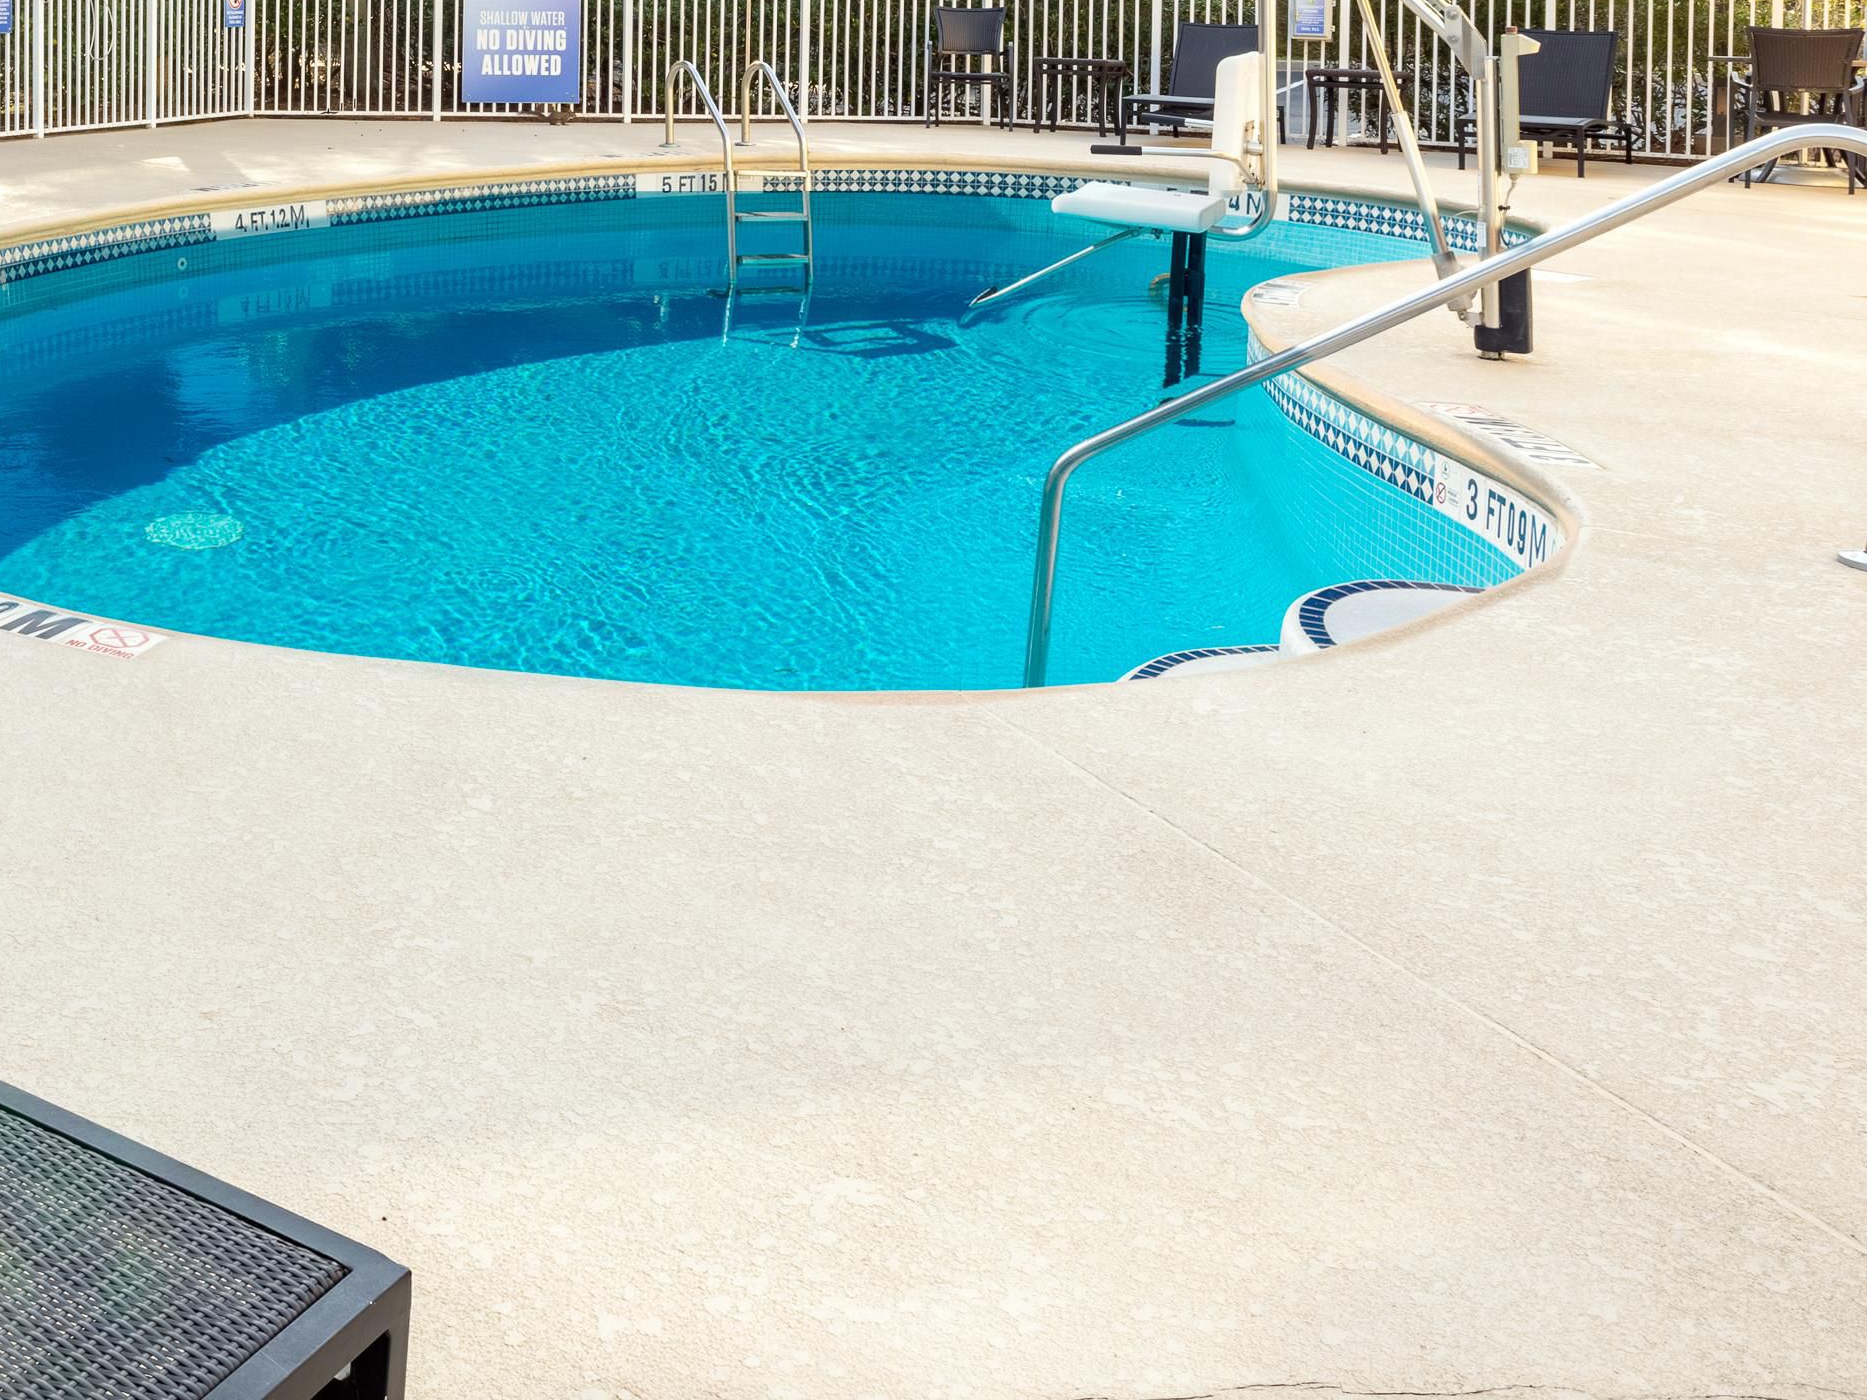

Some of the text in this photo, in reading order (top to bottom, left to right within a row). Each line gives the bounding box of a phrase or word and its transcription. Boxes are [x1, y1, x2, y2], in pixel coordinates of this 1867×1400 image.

[480, 10, 565, 26] SHALLOW WATER
[476, 29, 567, 51] NO DIVING
[481, 54, 562, 76] ALLOWED
[662, 177, 672, 193] 5
[679, 175, 696, 193] FT
[235, 213, 246, 232] 4
[290, 204, 310, 229] M
[1466, 478, 1479, 521] 3
[1486, 488, 1506, 539] FT
[1528, 514, 1547, 568] M
[65, 639, 134, 659] NO DIVING
